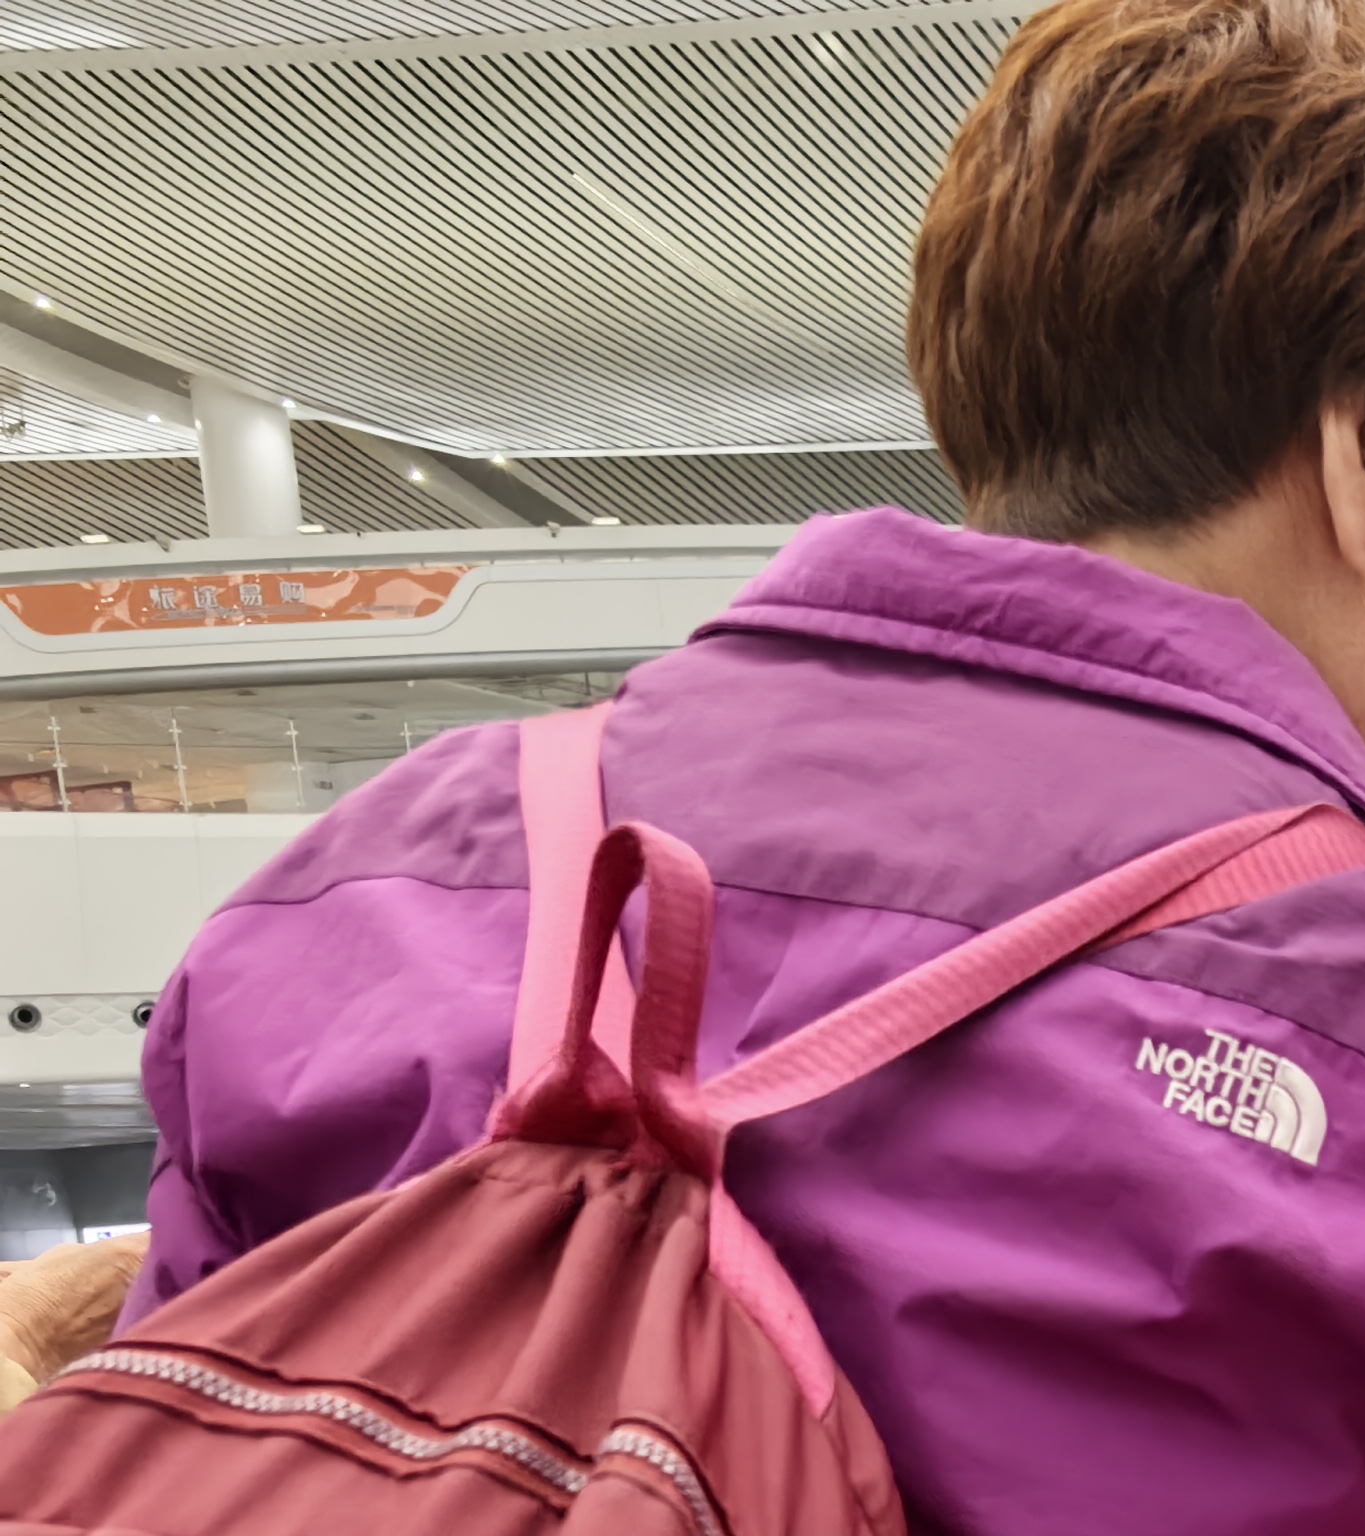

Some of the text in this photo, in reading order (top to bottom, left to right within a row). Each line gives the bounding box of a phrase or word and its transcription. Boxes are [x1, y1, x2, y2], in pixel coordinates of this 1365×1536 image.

[1135, 1037, 1271, 1110] NORTH
[1204, 1028, 1280, 1082] THE
[1163, 1079, 1260, 1139] FACE
